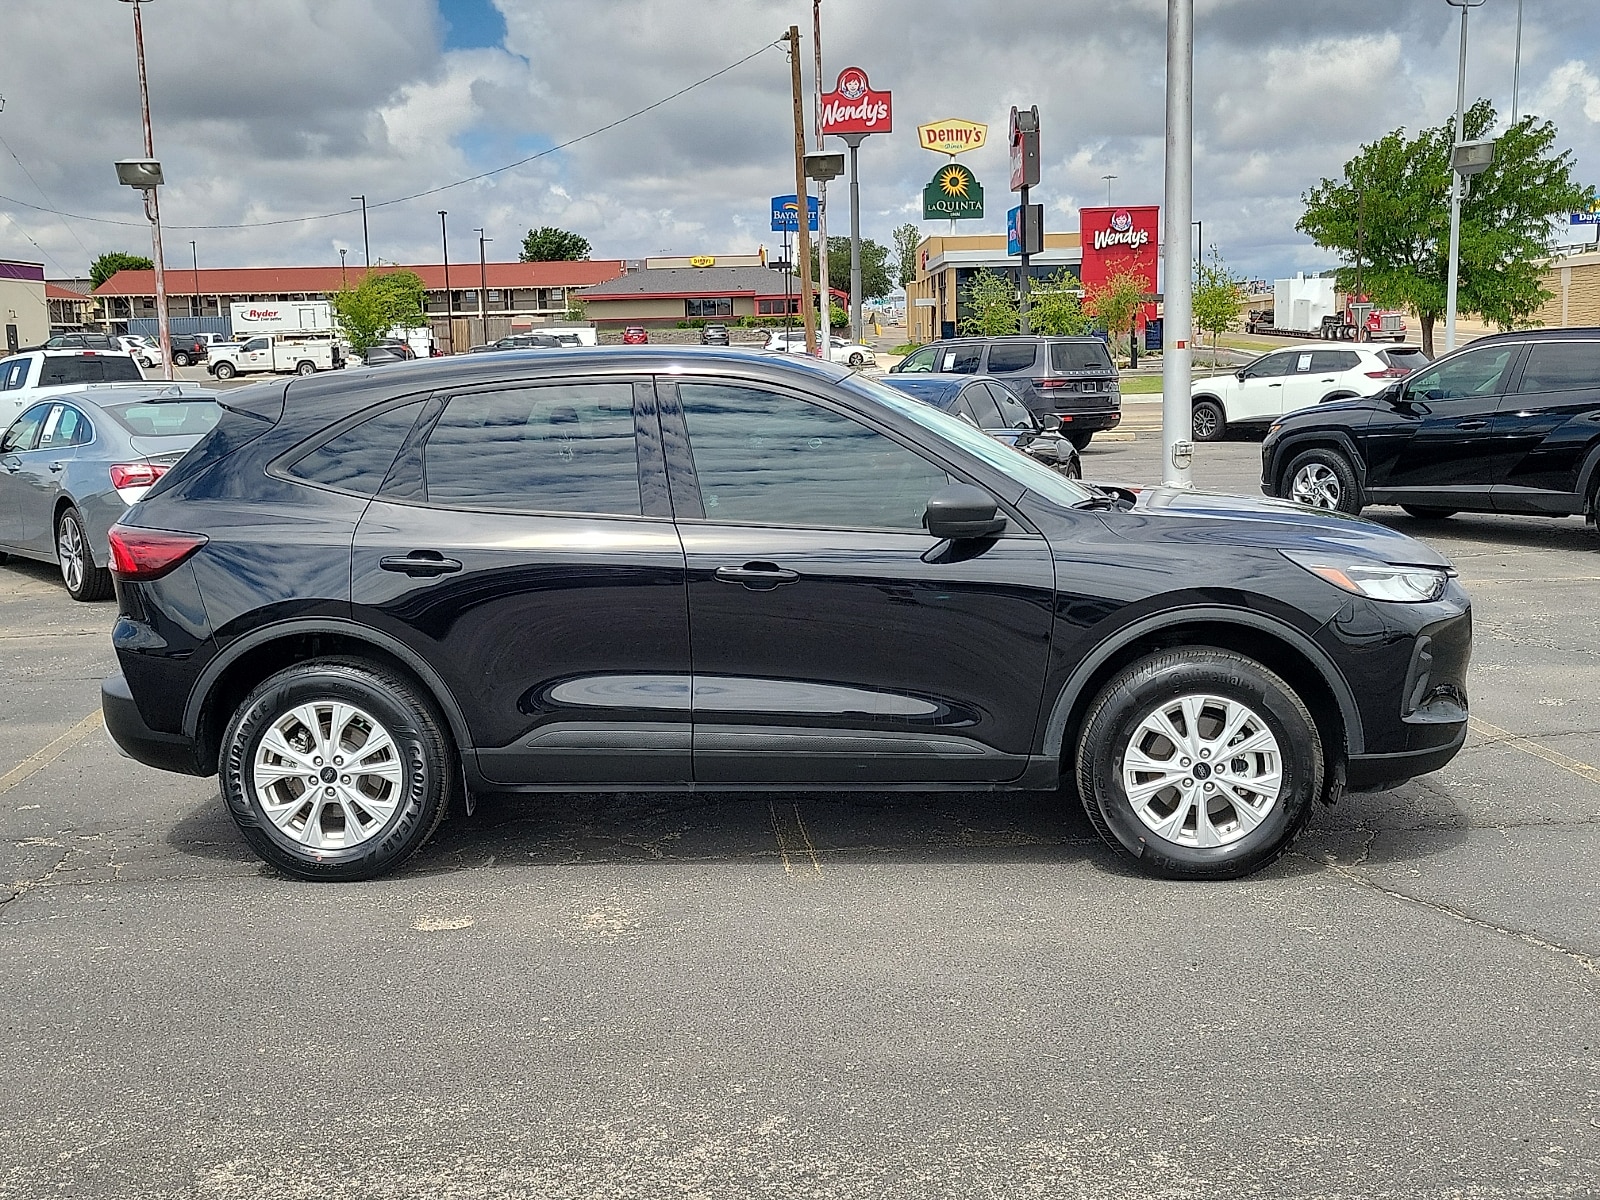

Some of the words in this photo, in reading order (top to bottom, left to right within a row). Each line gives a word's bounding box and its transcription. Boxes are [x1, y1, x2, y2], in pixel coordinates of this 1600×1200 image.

[821, 96, 888, 128] Wendy's
[925, 127, 982, 144] Denny's
[773, 210, 817, 220] BAYMNT
[936, 200, 983, 213] QUINTA
[1094, 225, 1149, 250] Wendy's
[250, 310, 278, 318] Ryder
[229, 701, 270, 804] ASSURANCE
[381, 743, 425, 853] GOODYEAR
